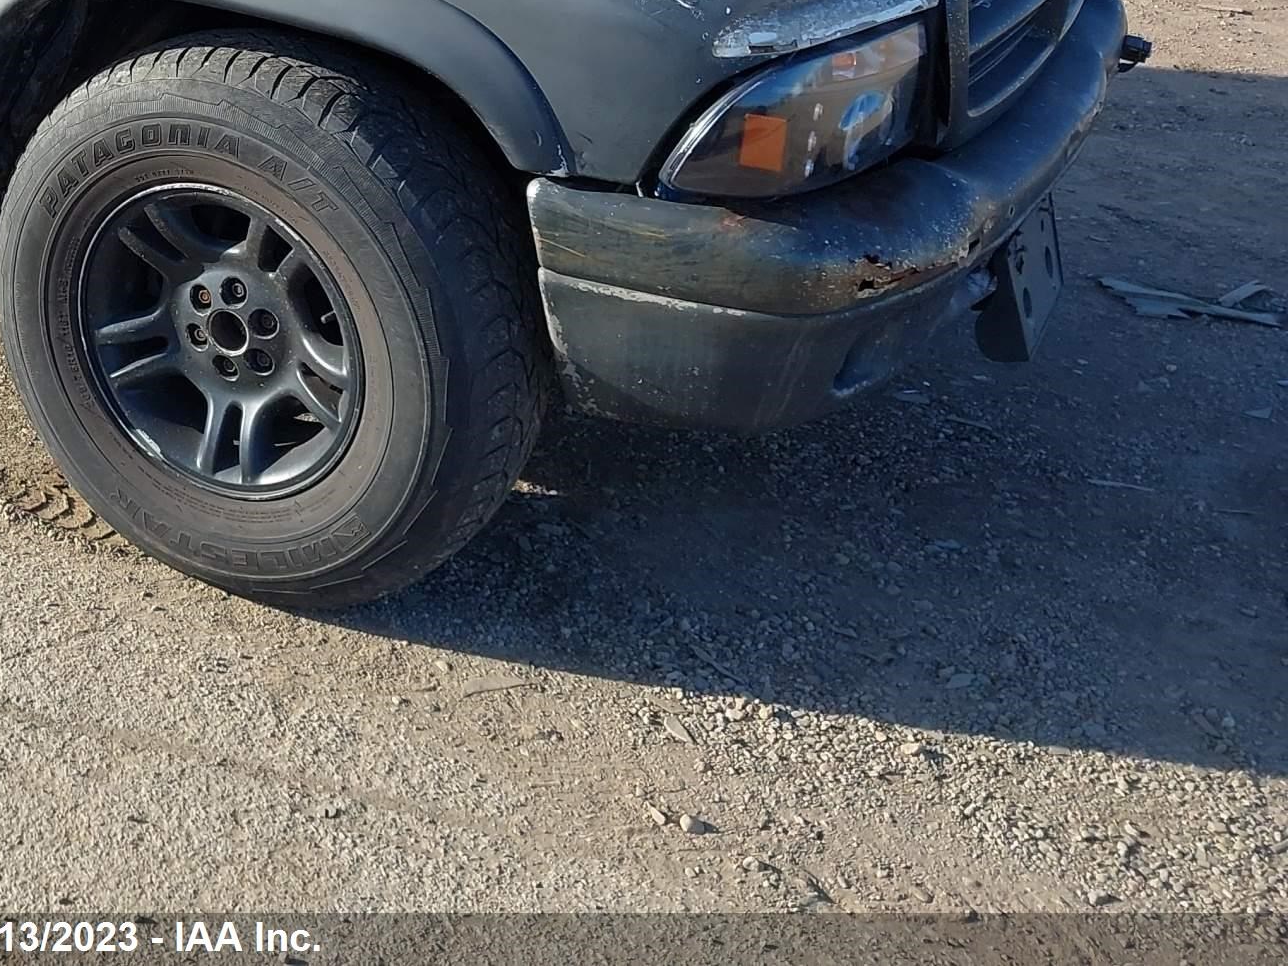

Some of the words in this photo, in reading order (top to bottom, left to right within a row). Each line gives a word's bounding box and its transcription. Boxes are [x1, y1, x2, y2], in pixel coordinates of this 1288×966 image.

[38, 122, 241, 219] PATAGONIA
[257, 154, 339, 214] A/T
[110, 487, 338, 571] MILESTAR
